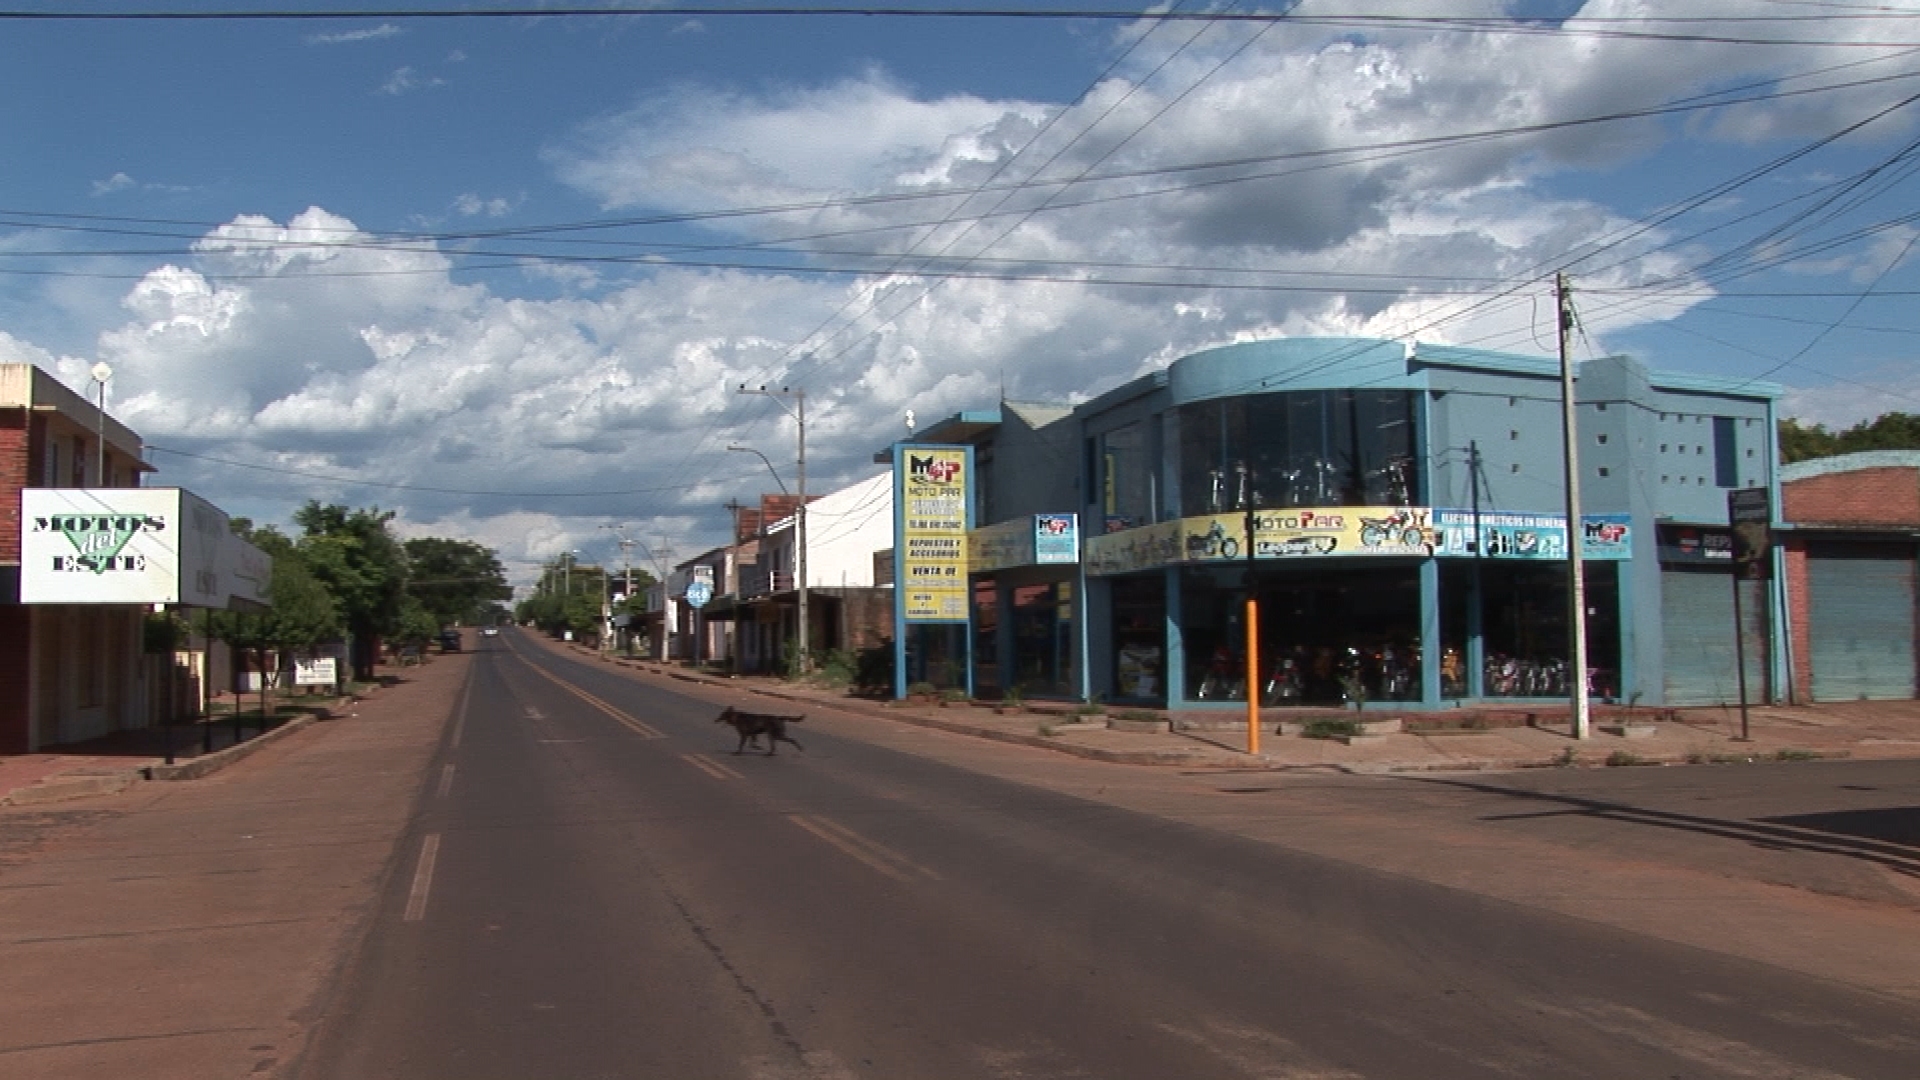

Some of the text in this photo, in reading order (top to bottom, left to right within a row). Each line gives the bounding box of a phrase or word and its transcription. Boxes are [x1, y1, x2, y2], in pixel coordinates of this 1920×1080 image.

[32, 516, 166, 532] MOTOS
[81, 530, 118, 555] del
[909, 539, 954, 547] REPUESTOS
[909, 549, 960, 558] ACCESORIOS
[53, 555, 147, 571] ESTE
[912, 567, 941, 576] VENTA
